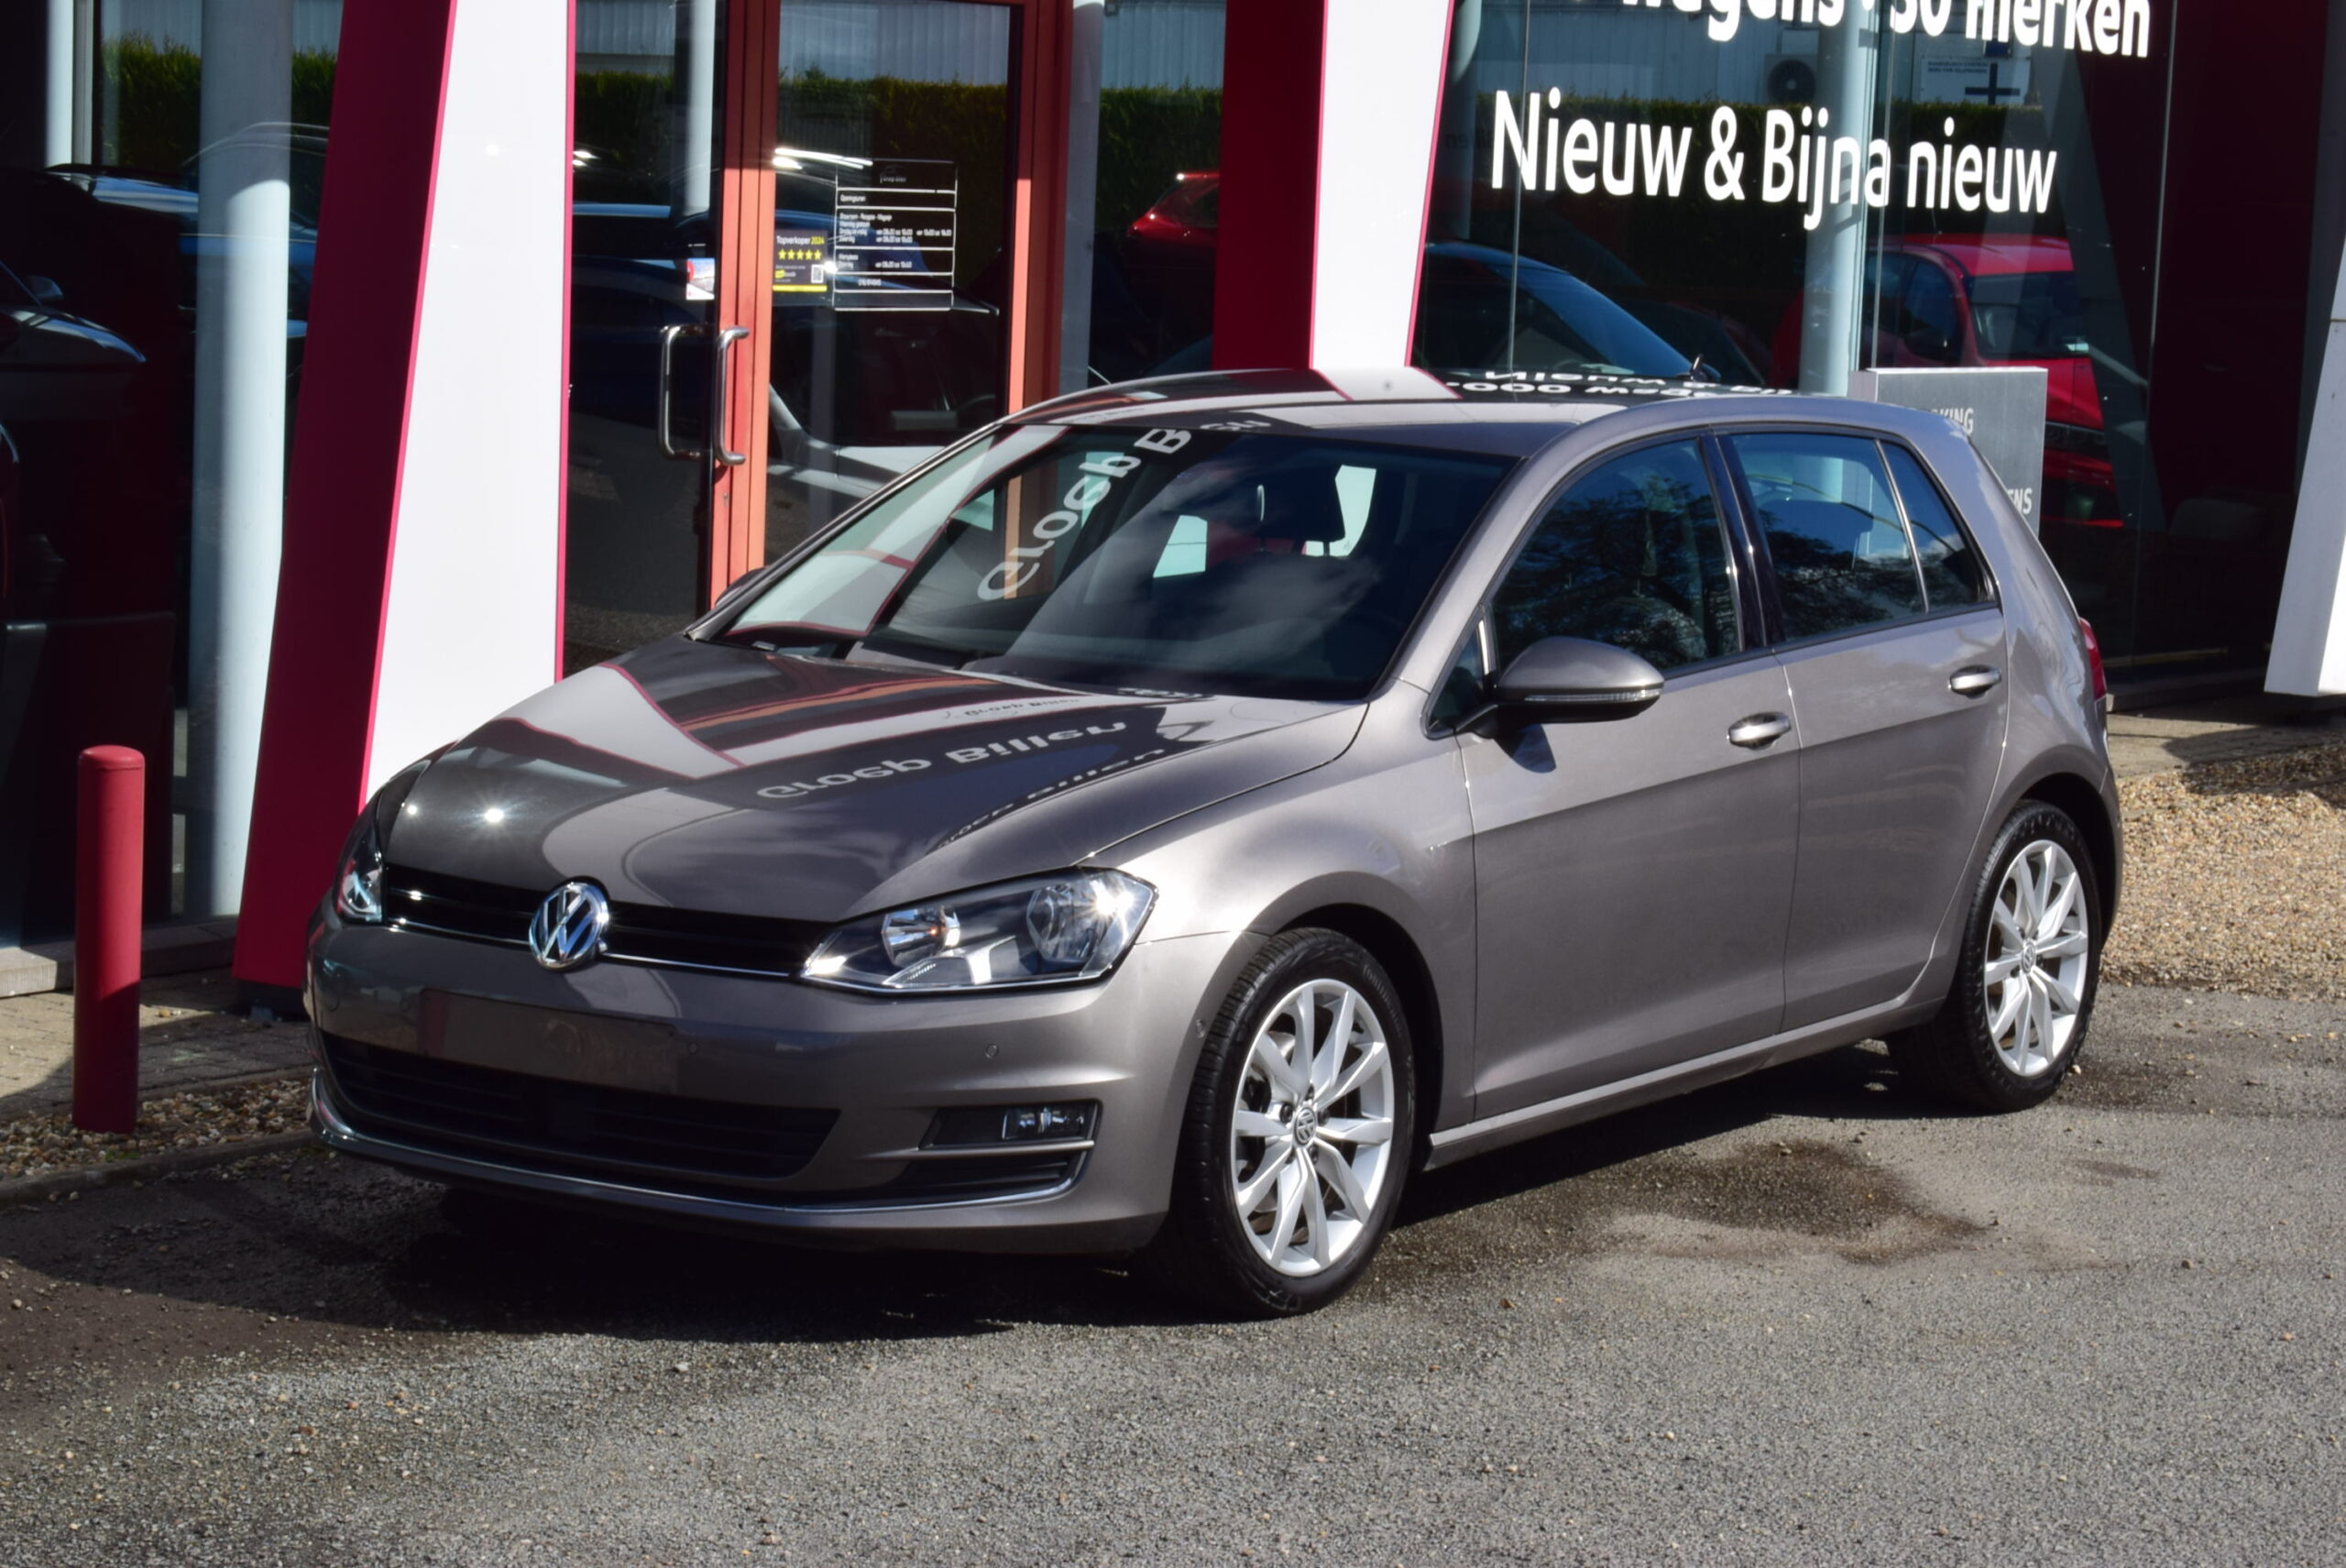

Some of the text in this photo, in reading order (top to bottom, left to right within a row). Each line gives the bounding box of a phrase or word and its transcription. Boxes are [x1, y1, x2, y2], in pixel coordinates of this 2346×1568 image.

[1966, 0, 2151, 58] merken
[1492, 86, 2057, 230] Nieuw & Bijna nieuw
